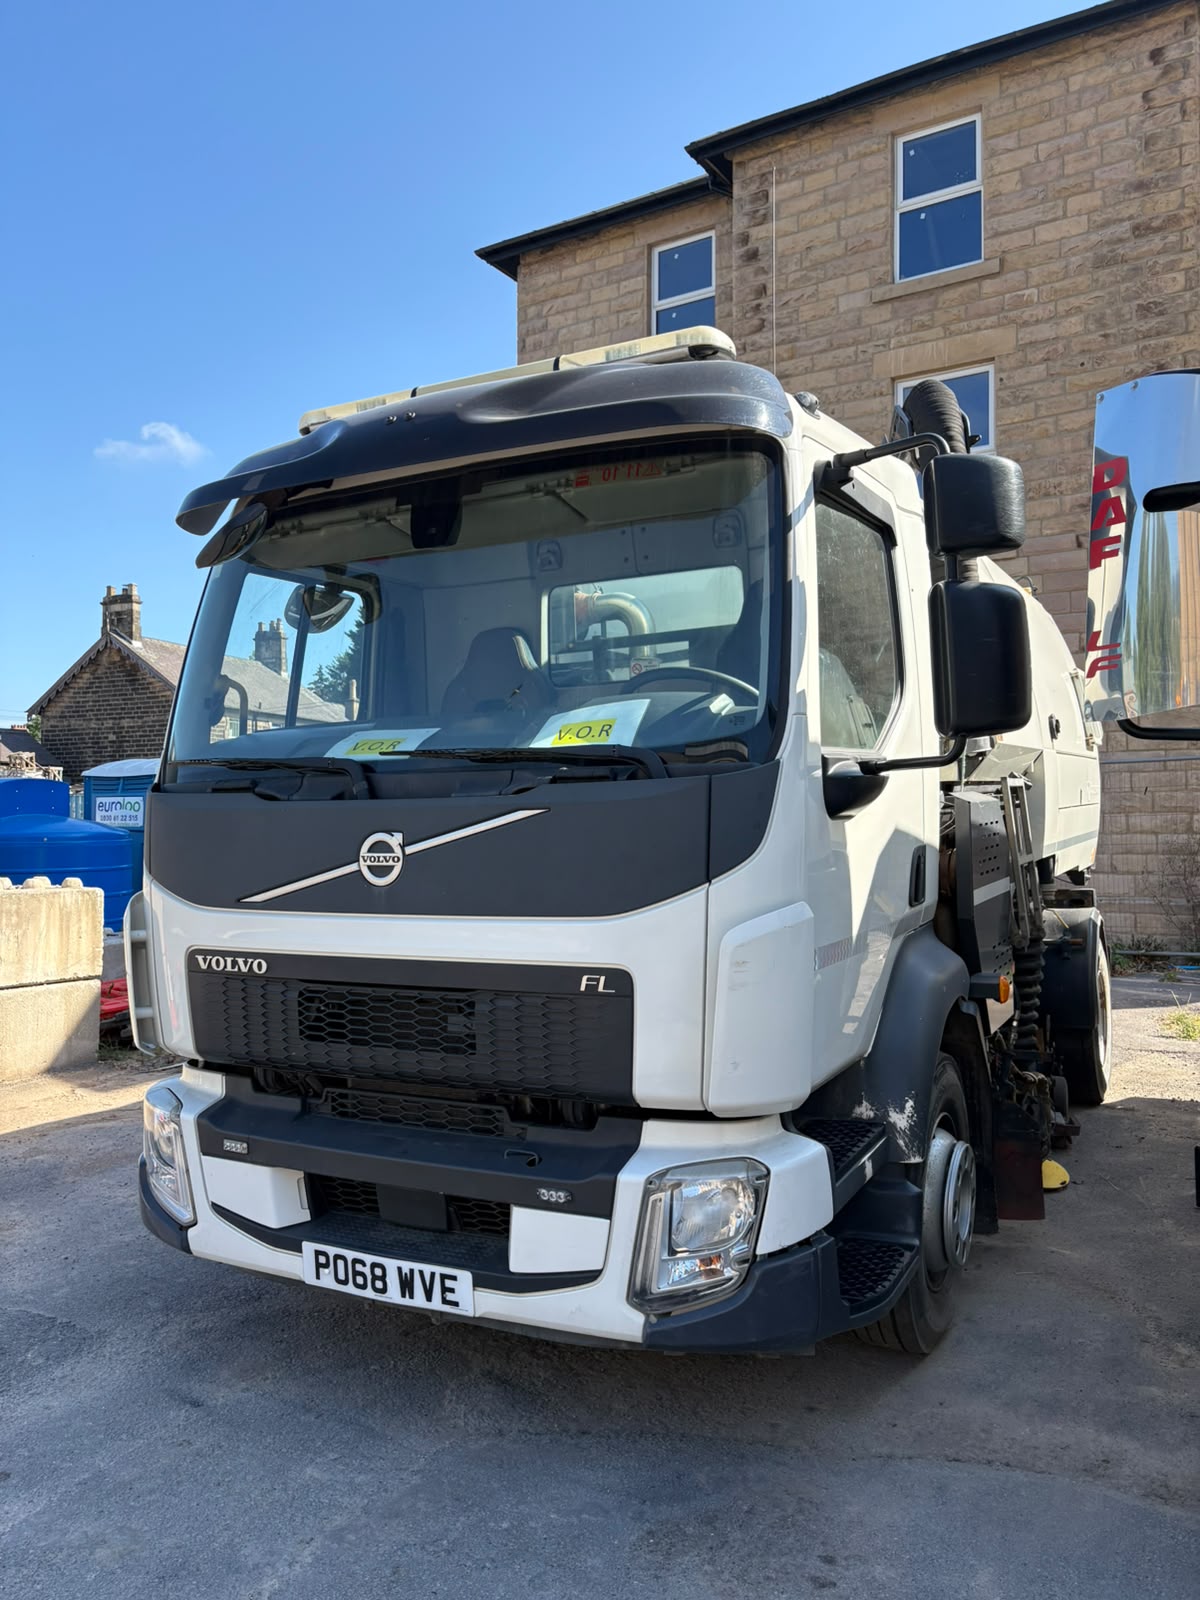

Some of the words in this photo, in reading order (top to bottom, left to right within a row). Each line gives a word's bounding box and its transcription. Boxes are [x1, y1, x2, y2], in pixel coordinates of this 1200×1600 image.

[1089, 456, 1129, 570] DAF
[1086, 630, 1122, 679] LF
[558, 724, 612, 741] V.O.R
[98, 798, 140, 812] euroloo
[120, 814, 127, 822] 22
[128, 814, 138, 822] 515
[361, 855, 401, 863] VOLVO
[195, 954, 268, 974] VOLVO
[580, 974, 616, 993] FL
[314, 1249, 388, 1295] PO68
[397, 1266, 460, 1308] WVE
